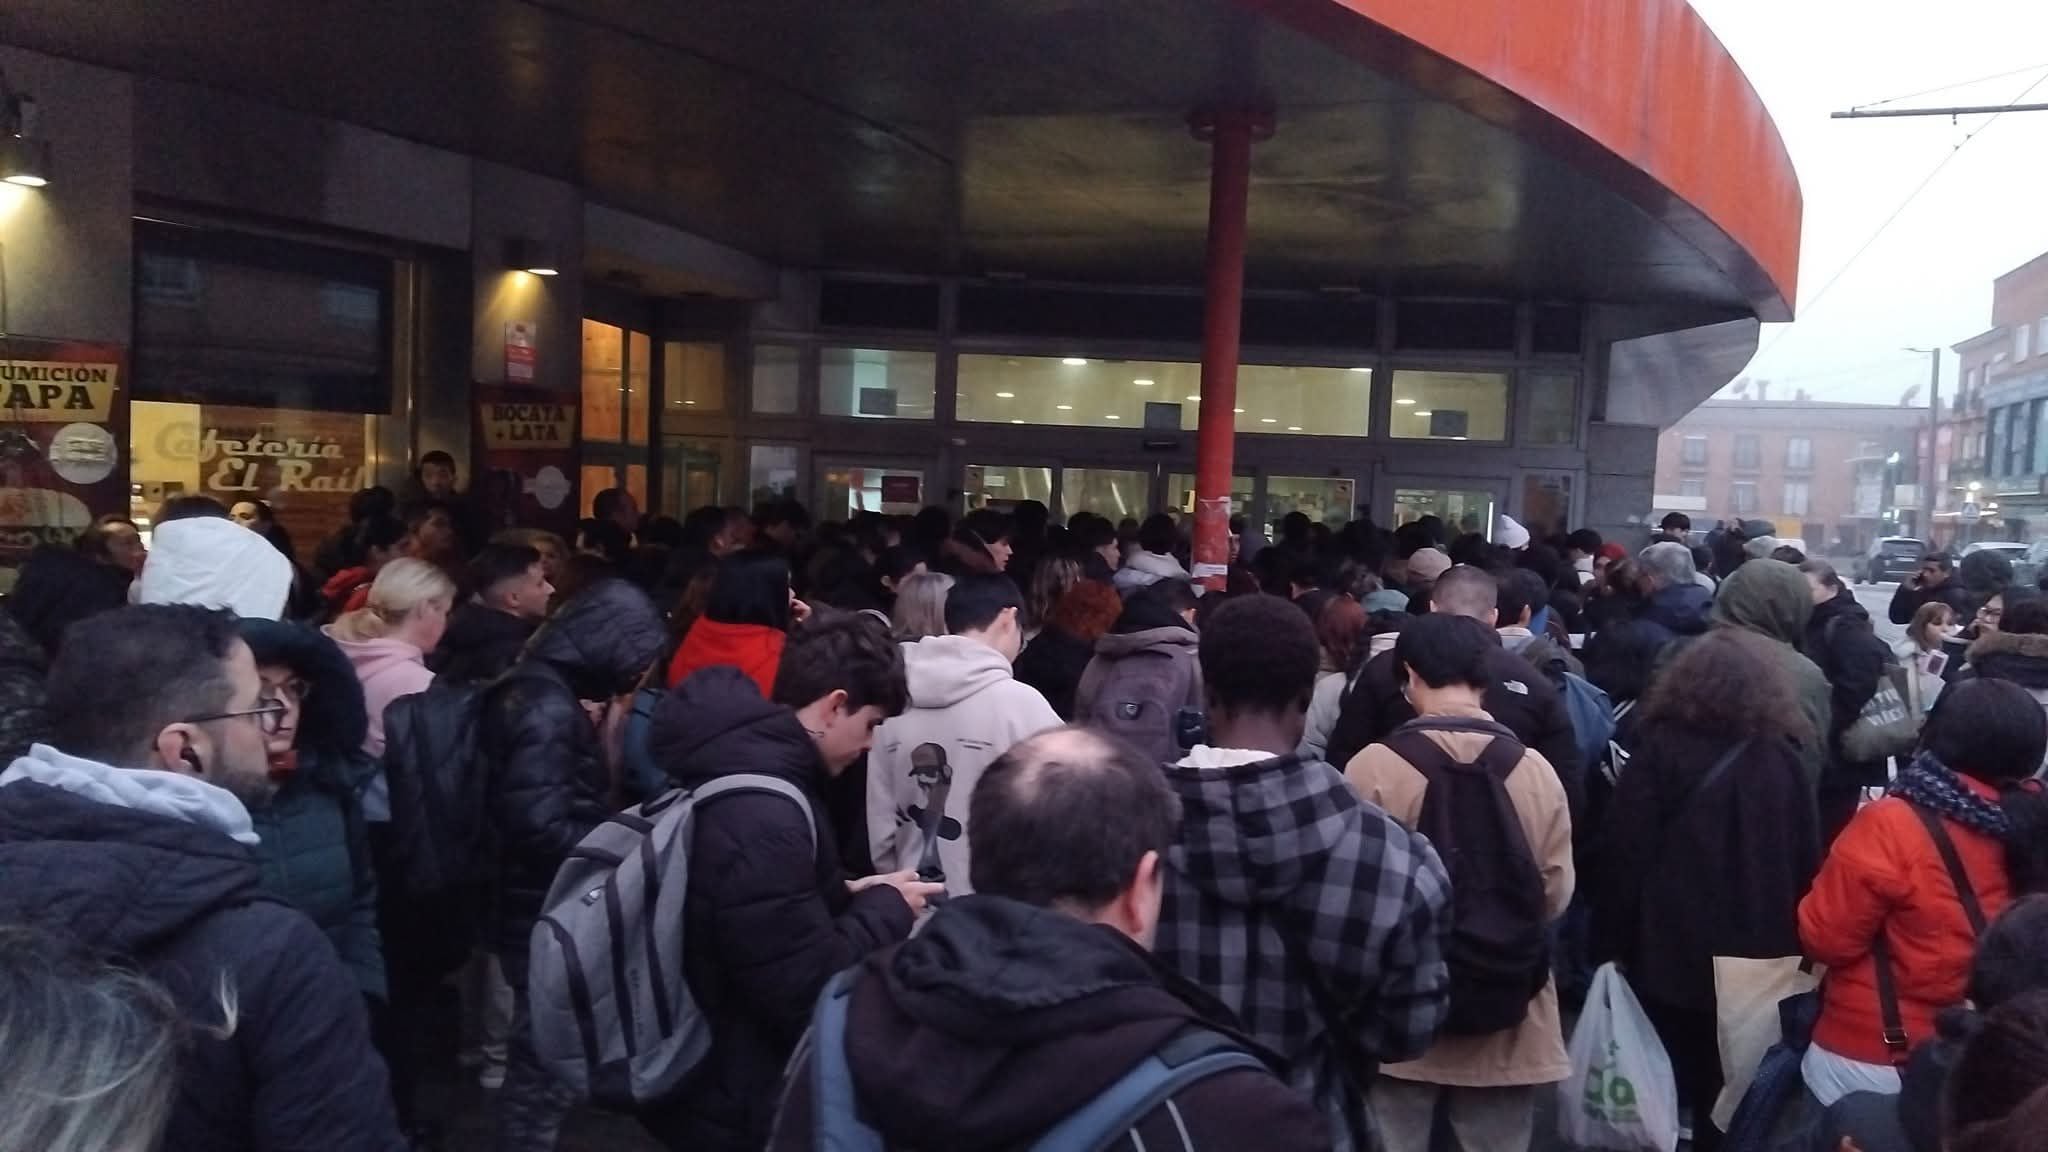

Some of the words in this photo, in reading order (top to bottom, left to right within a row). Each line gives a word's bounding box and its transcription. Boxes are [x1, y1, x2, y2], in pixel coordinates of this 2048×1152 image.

[0, 384, 95, 409] APA
[509, 423, 560, 441] LATA
[208, 457, 259, 491] El
